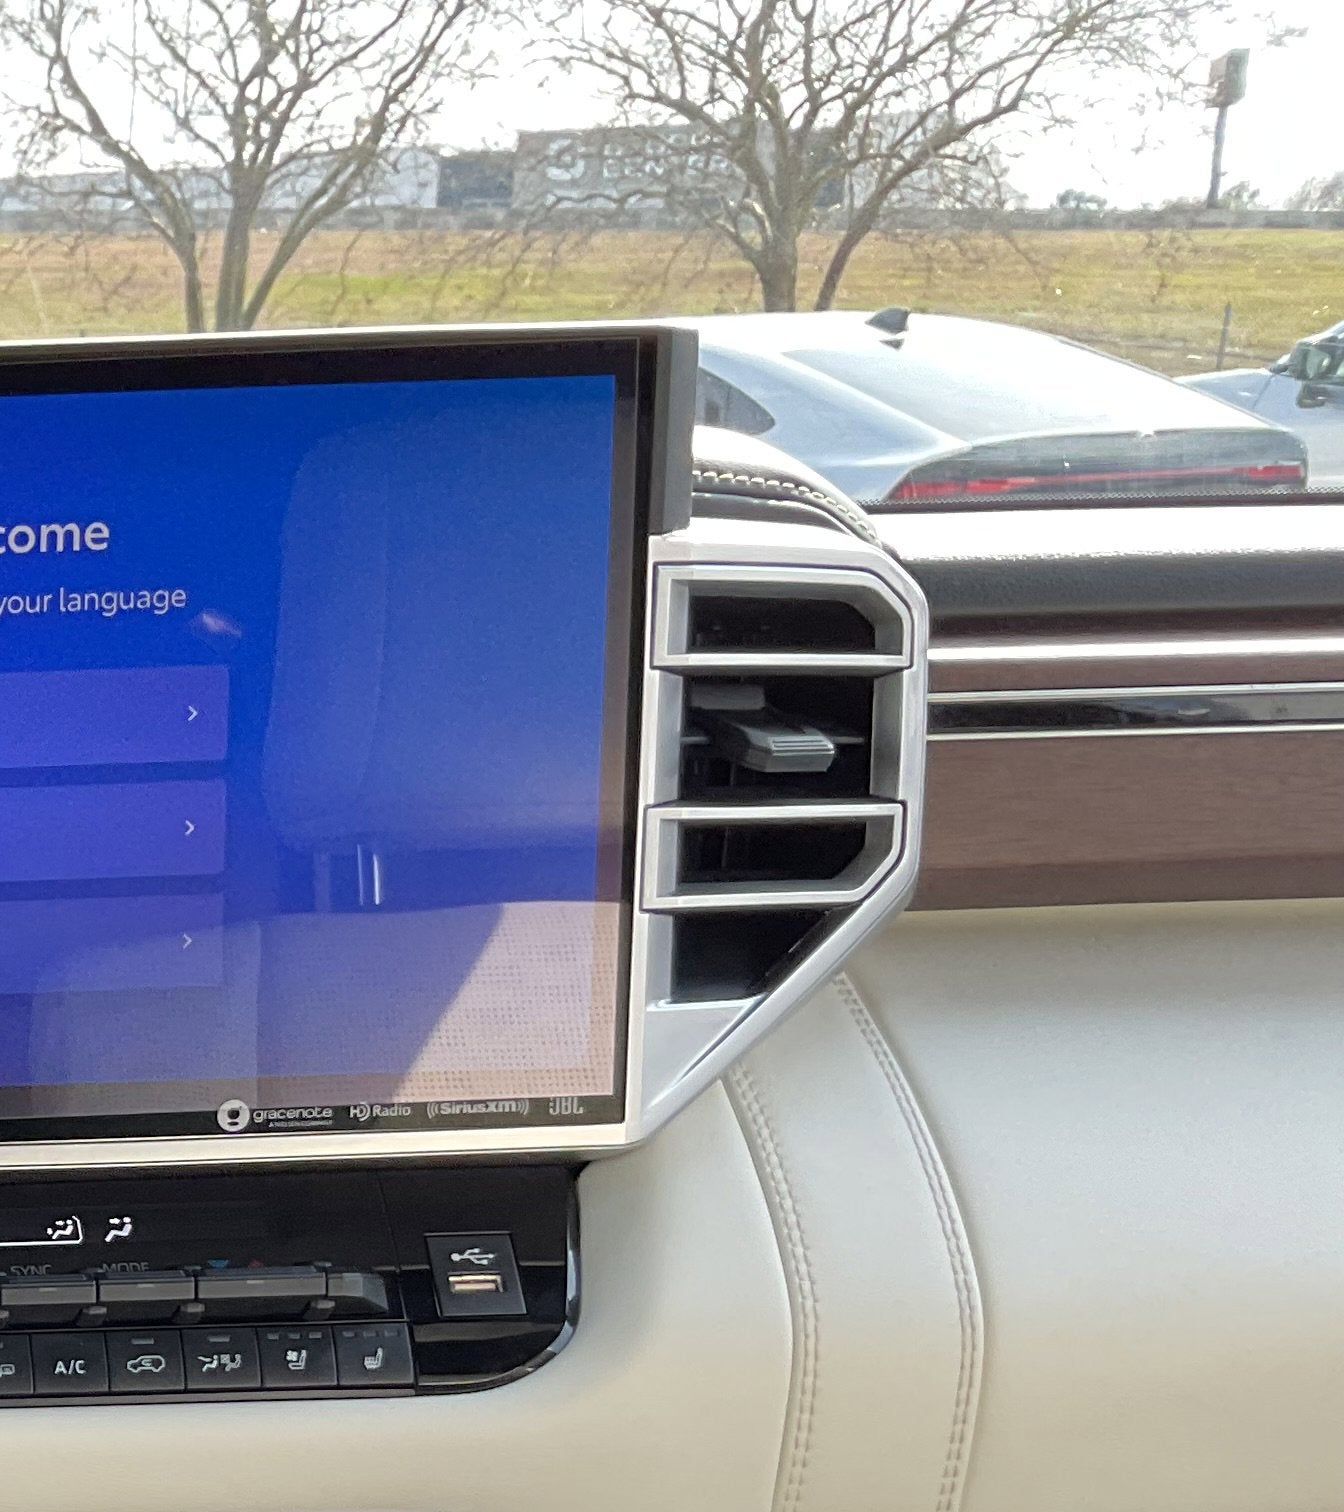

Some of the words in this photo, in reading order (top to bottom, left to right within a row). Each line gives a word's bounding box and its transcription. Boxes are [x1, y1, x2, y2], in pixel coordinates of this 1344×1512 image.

[59, 587, 188, 618] language
[252, 1104, 333, 1123] gracenote
[372, 1103, 412, 1117] Radio
[548, 1097, 584, 1116] JBL
[10, 1264, 52, 1276] SYNC
[102, 1261, 150, 1273] MODE
[54, 1360, 86, 1375] A/C
